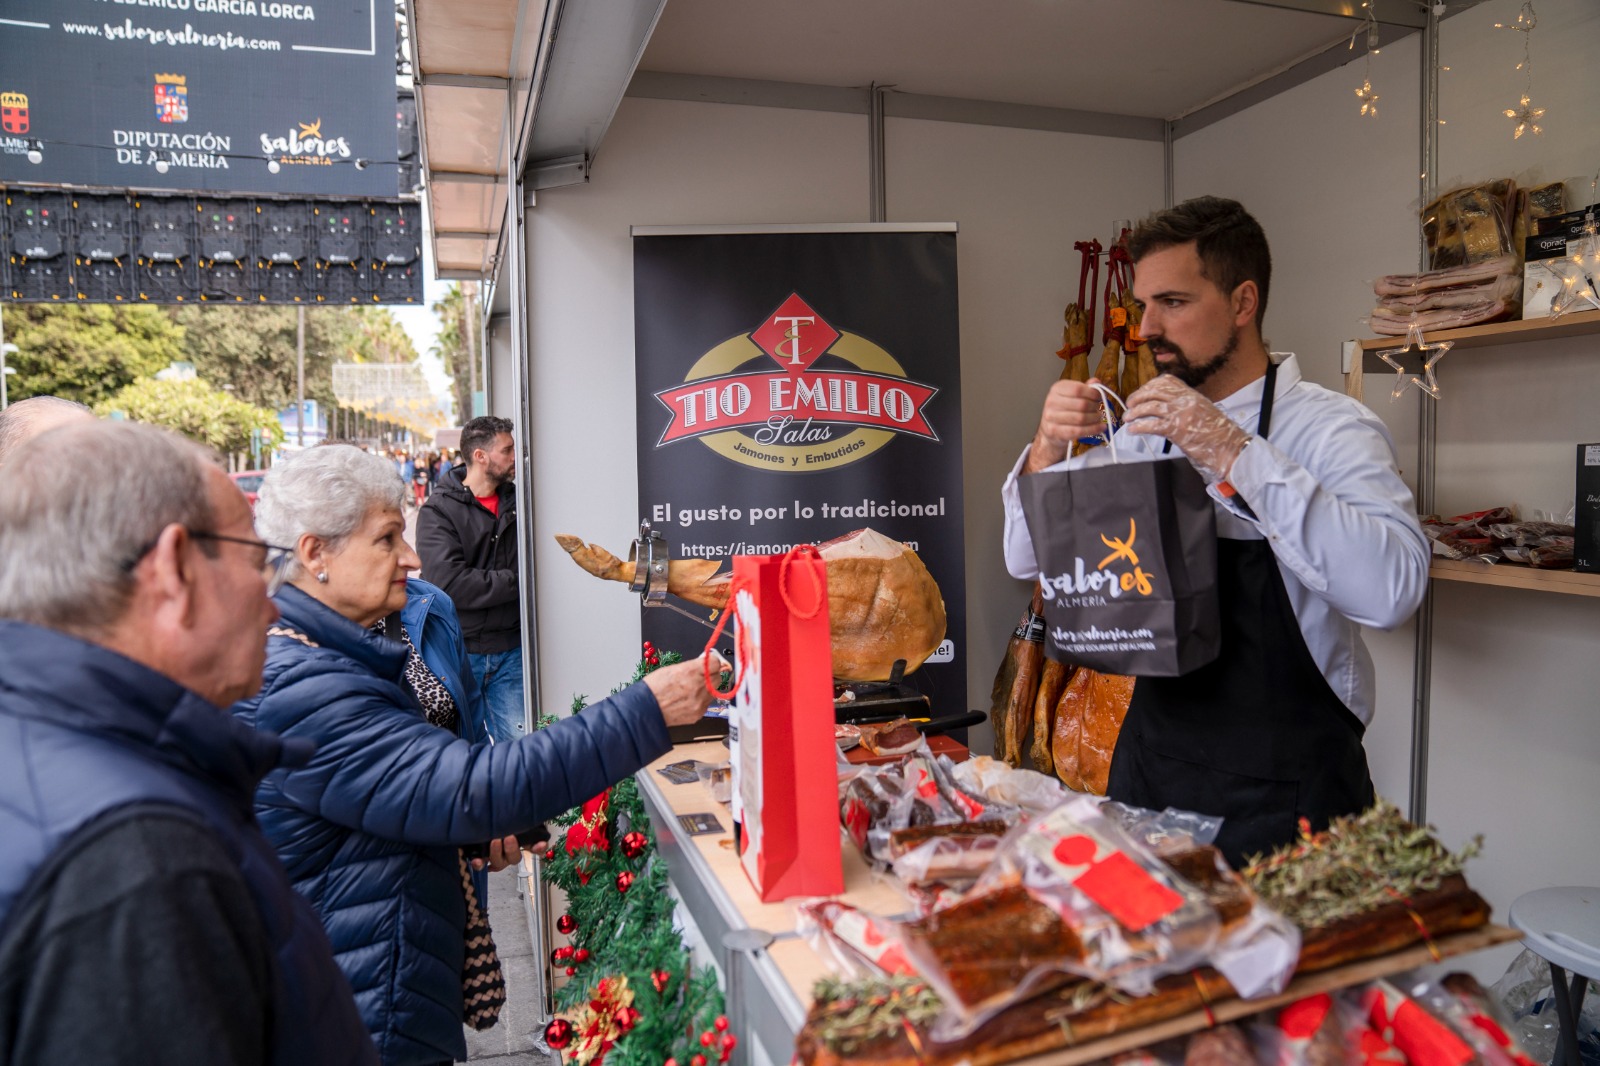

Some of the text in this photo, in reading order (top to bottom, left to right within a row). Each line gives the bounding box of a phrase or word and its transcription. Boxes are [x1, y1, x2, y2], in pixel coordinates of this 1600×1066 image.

[261, 4, 316, 21] LORCA
[113, 130, 231, 151] DIPUTACIÓN
[116, 148, 143, 165] DE
[675, 377, 916, 428] TIO EMILIO
[754, 414, 832, 446] Salas
[733, 437, 866, 467] Jamones y Embutidos
[652, 497, 945, 527] El gusto por lo tradicional
[1056, 594, 1107, 608] ALMERÍA
